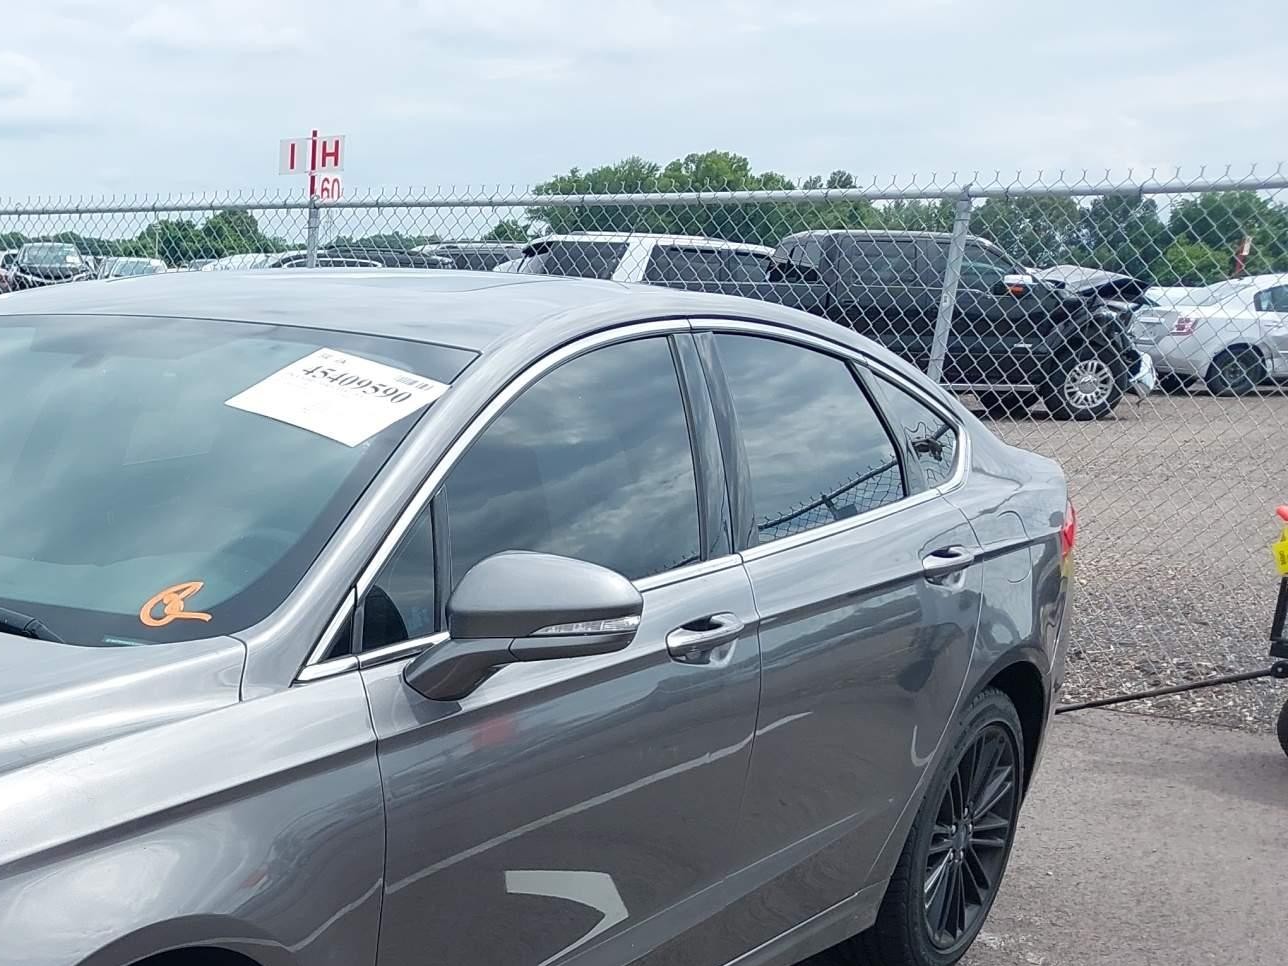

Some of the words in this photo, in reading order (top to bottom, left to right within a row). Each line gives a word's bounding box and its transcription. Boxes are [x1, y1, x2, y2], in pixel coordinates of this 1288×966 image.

[321, 139, 340, 168] H
[320, 177, 341, 201] 60
[302, 365, 413, 404] 45409590
